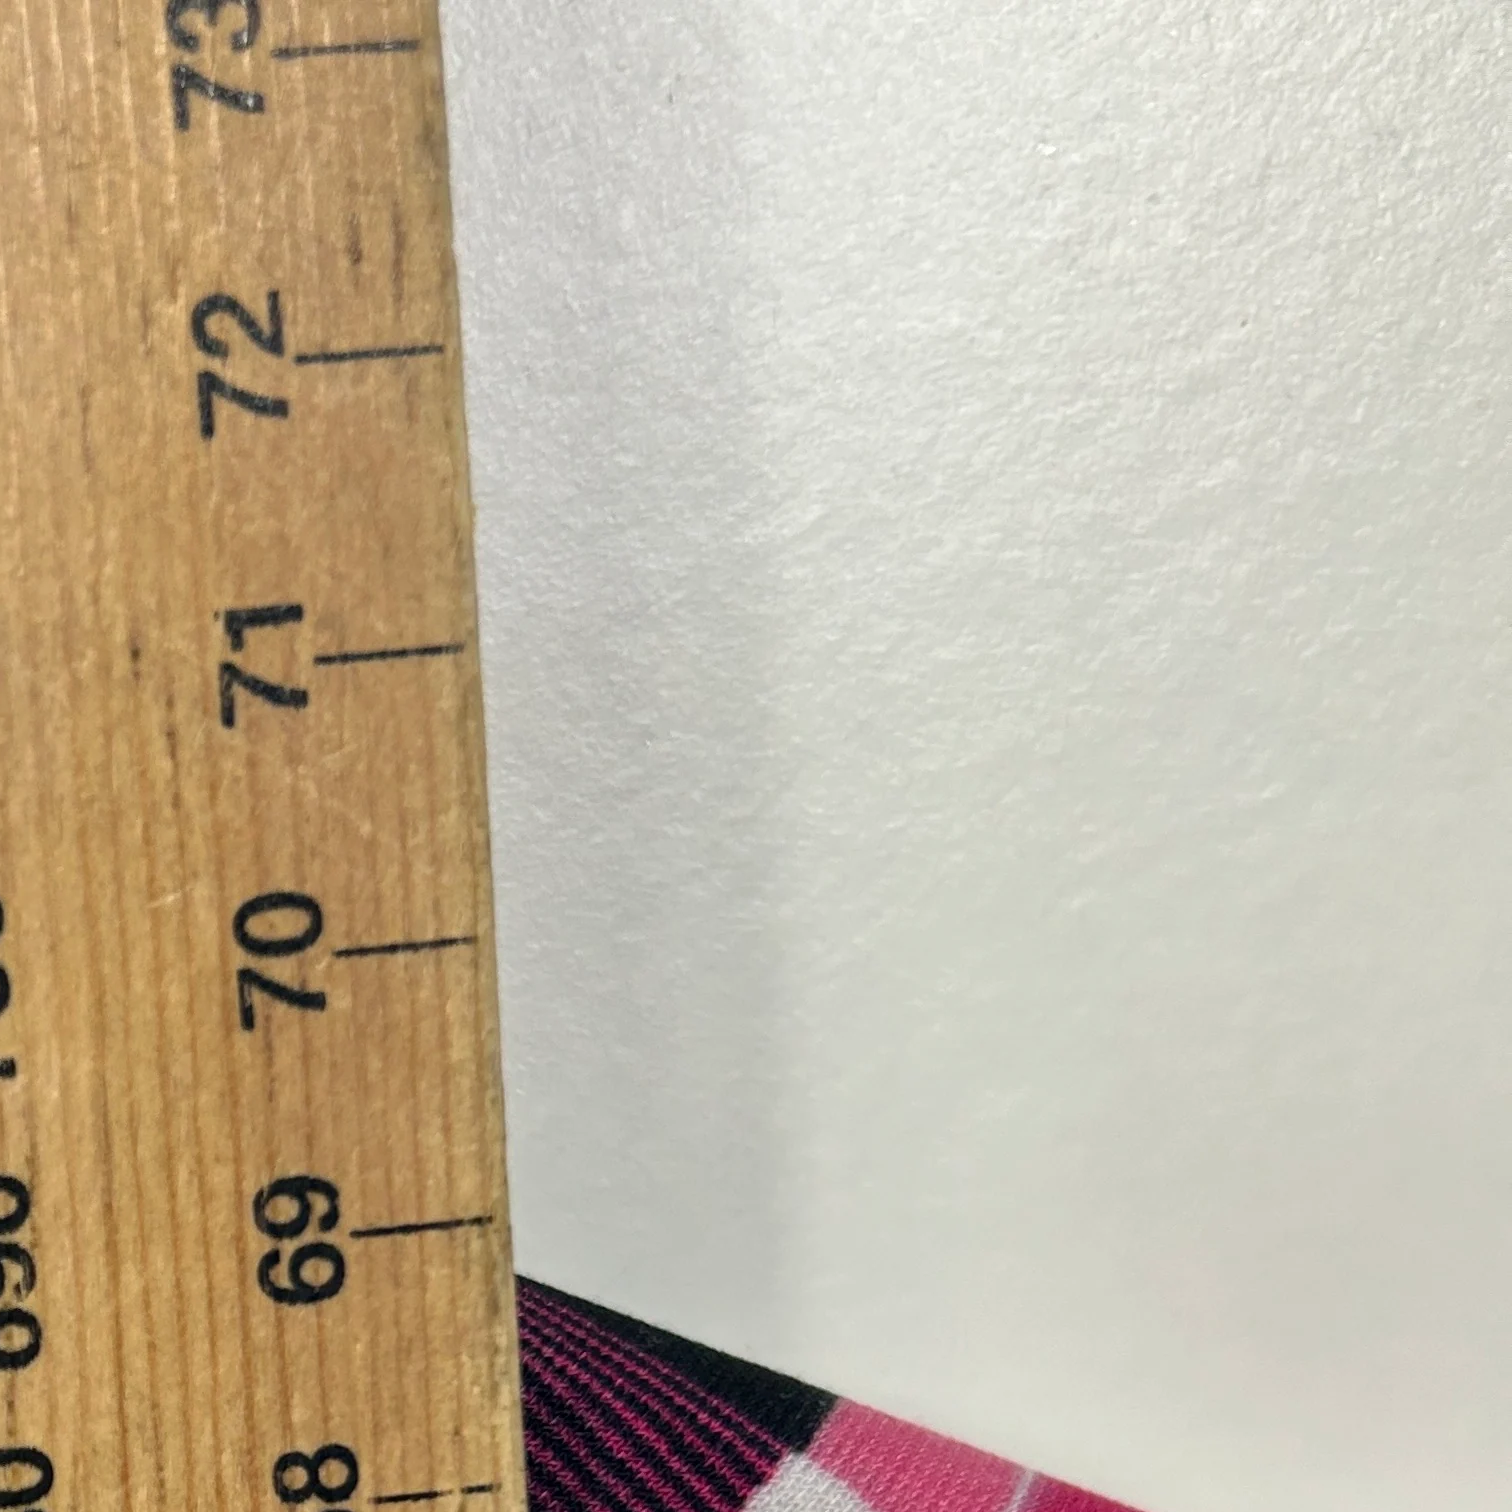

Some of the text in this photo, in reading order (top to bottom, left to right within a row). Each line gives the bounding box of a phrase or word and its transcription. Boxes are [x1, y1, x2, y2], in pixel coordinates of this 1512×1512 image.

[165, 0, 265, 131] 73
[190, 289, 290, 439] 72
[216, 603, 308, 730] 71
[233, 891, 326, 1030] 70
[254, 1173, 346, 1305] 69
